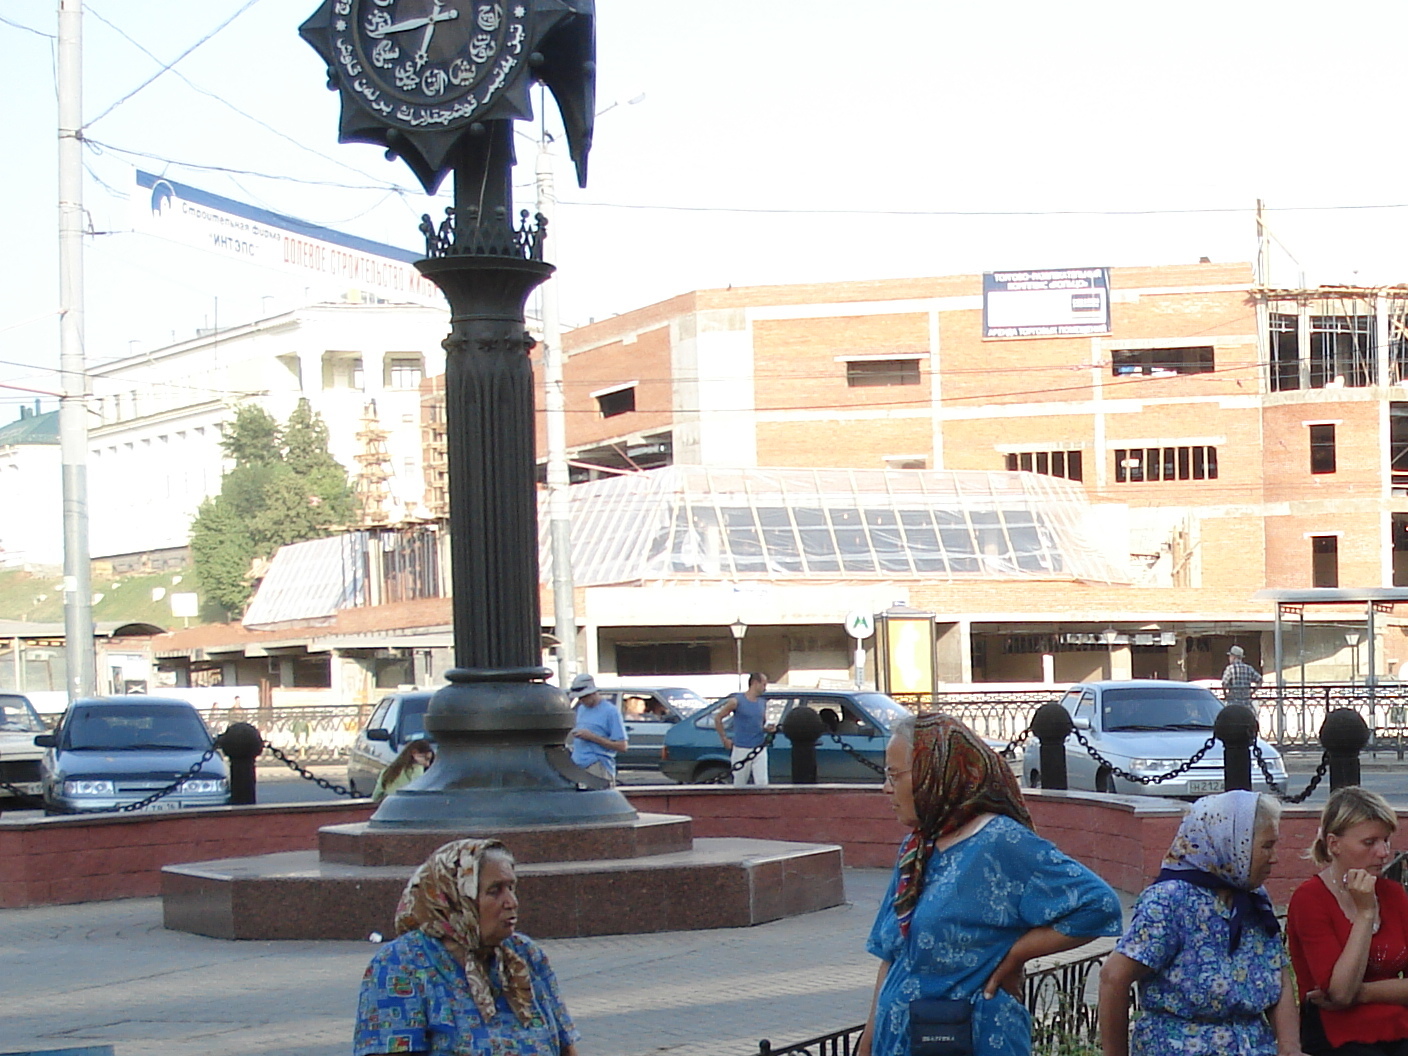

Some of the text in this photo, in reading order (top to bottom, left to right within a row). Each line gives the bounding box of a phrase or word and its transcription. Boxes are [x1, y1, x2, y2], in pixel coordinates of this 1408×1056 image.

[182, 201, 282, 242] Строительная фирма
[283, 236, 327, 272] ДОЛЕВОЕ
[330, 249, 405, 291] СТРОИТЕЛЬСТВО
